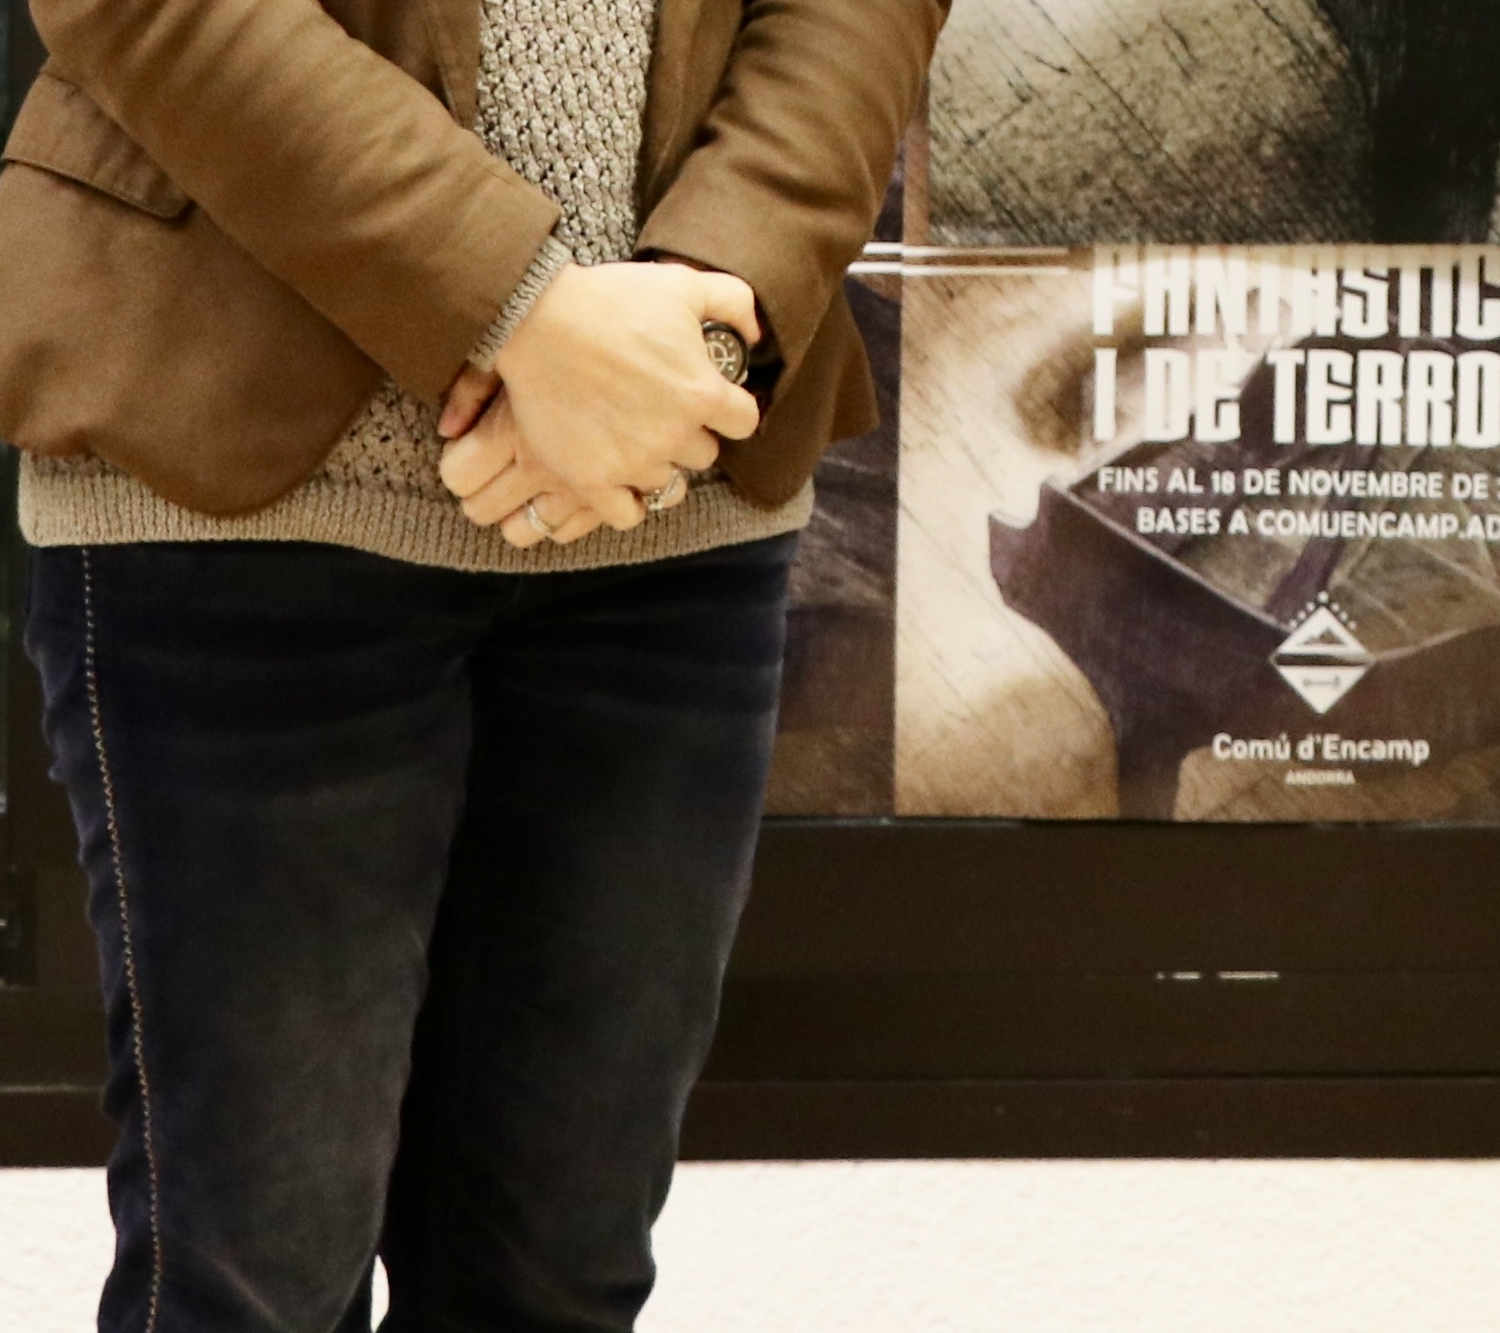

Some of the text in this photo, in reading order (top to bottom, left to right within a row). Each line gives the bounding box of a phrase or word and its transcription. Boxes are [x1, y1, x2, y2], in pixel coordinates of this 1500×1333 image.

[1092, 346, 1121, 442] I
[1143, 347, 1243, 444] DE
[1098, 468, 1158, 495] FINS
[1167, 469, 1204, 496] AL
[1212, 470, 1237, 496] 18
[1244, 470, 1284, 497] DE
[1289, 471, 1444, 500] NOVEMBRE
[1451, 474, 1489, 501] DE
[1136, 508, 1222, 536] BASES
[1227, 510, 1251, 537] A
[1213, 732, 1430, 767] Comú d'Encamp
